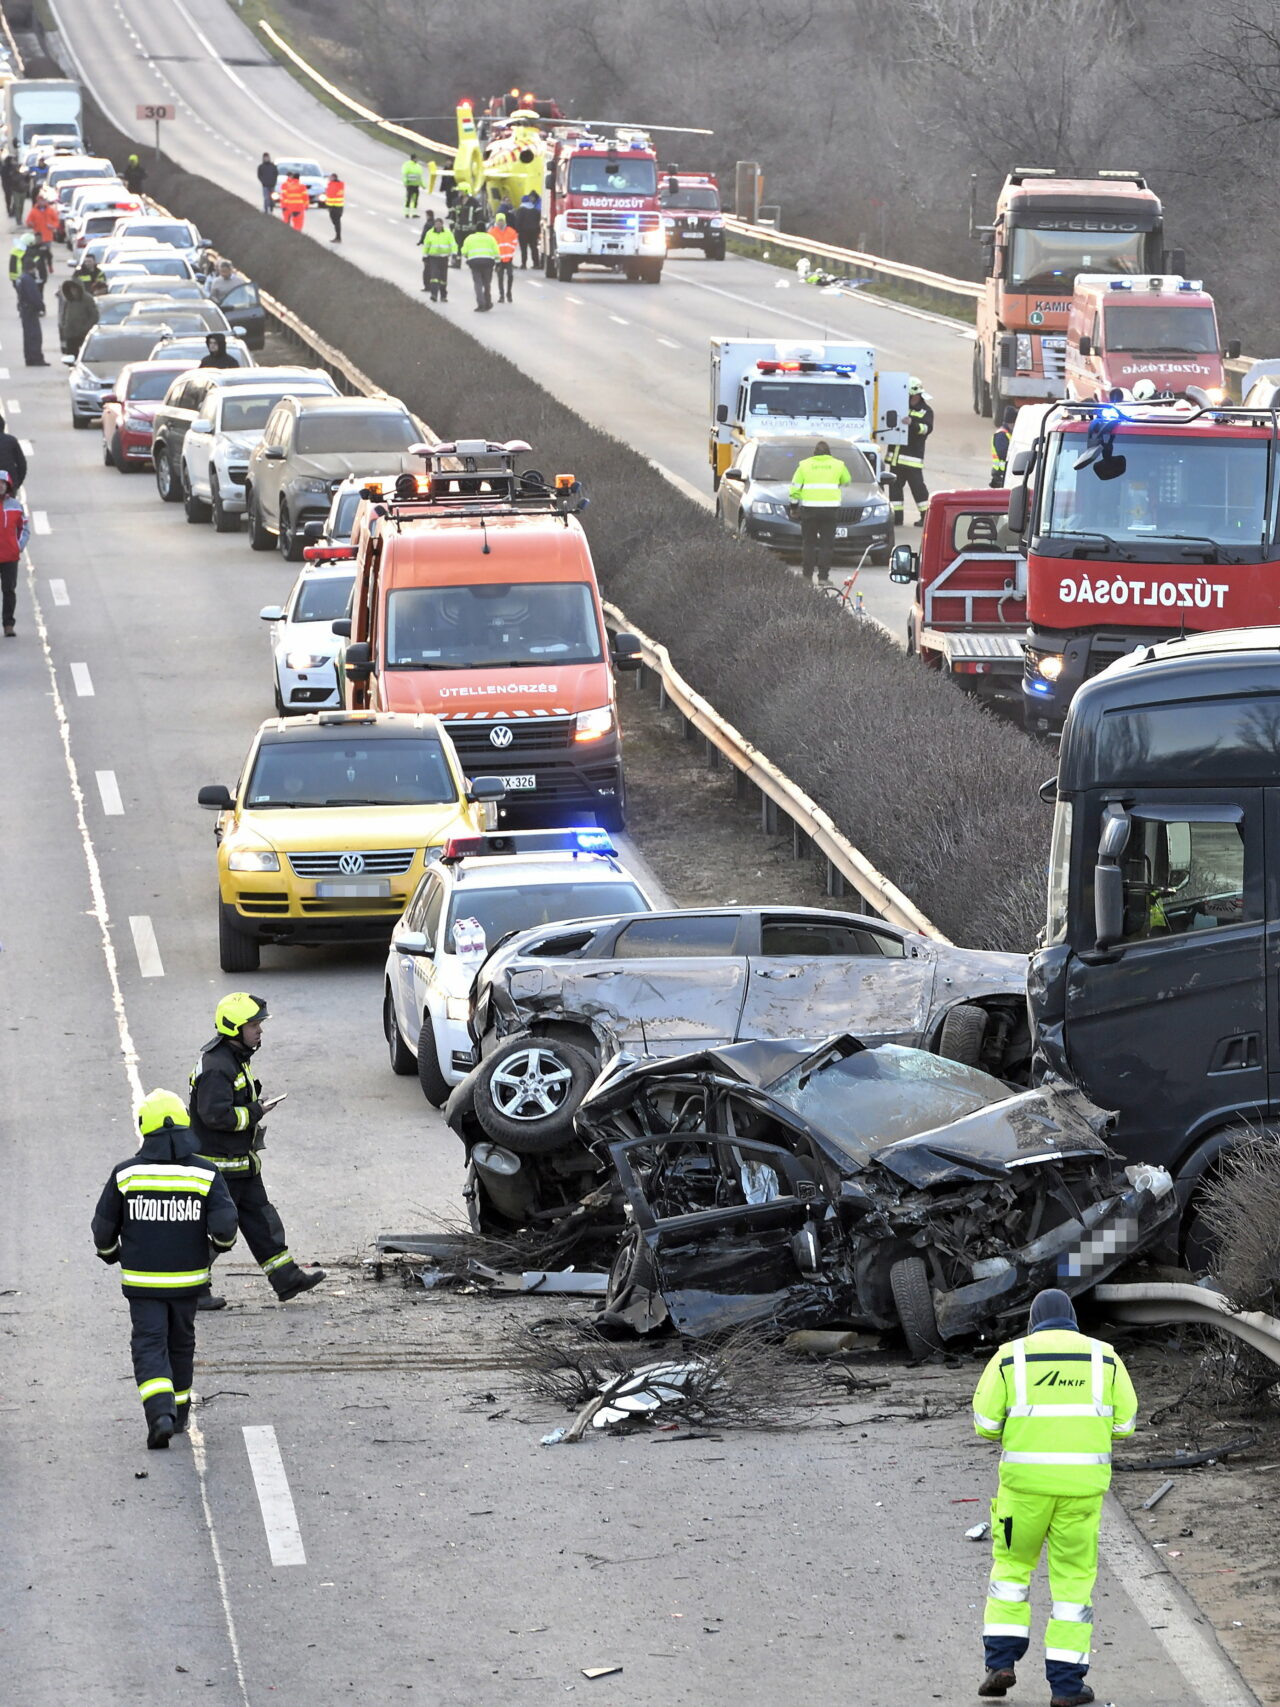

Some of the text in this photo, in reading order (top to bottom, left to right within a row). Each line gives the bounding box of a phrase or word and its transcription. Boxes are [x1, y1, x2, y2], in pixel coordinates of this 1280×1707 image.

[145, 106, 167, 119] 30
[1037, 220, 1138, 231] SPEEDO
[439, 683, 559, 698] ÚTELLENŐRZÉS
[127, 1195, 201, 1222] TŰZOLTÓSÁG
[1058, 1379, 1086, 1387] MKIF
